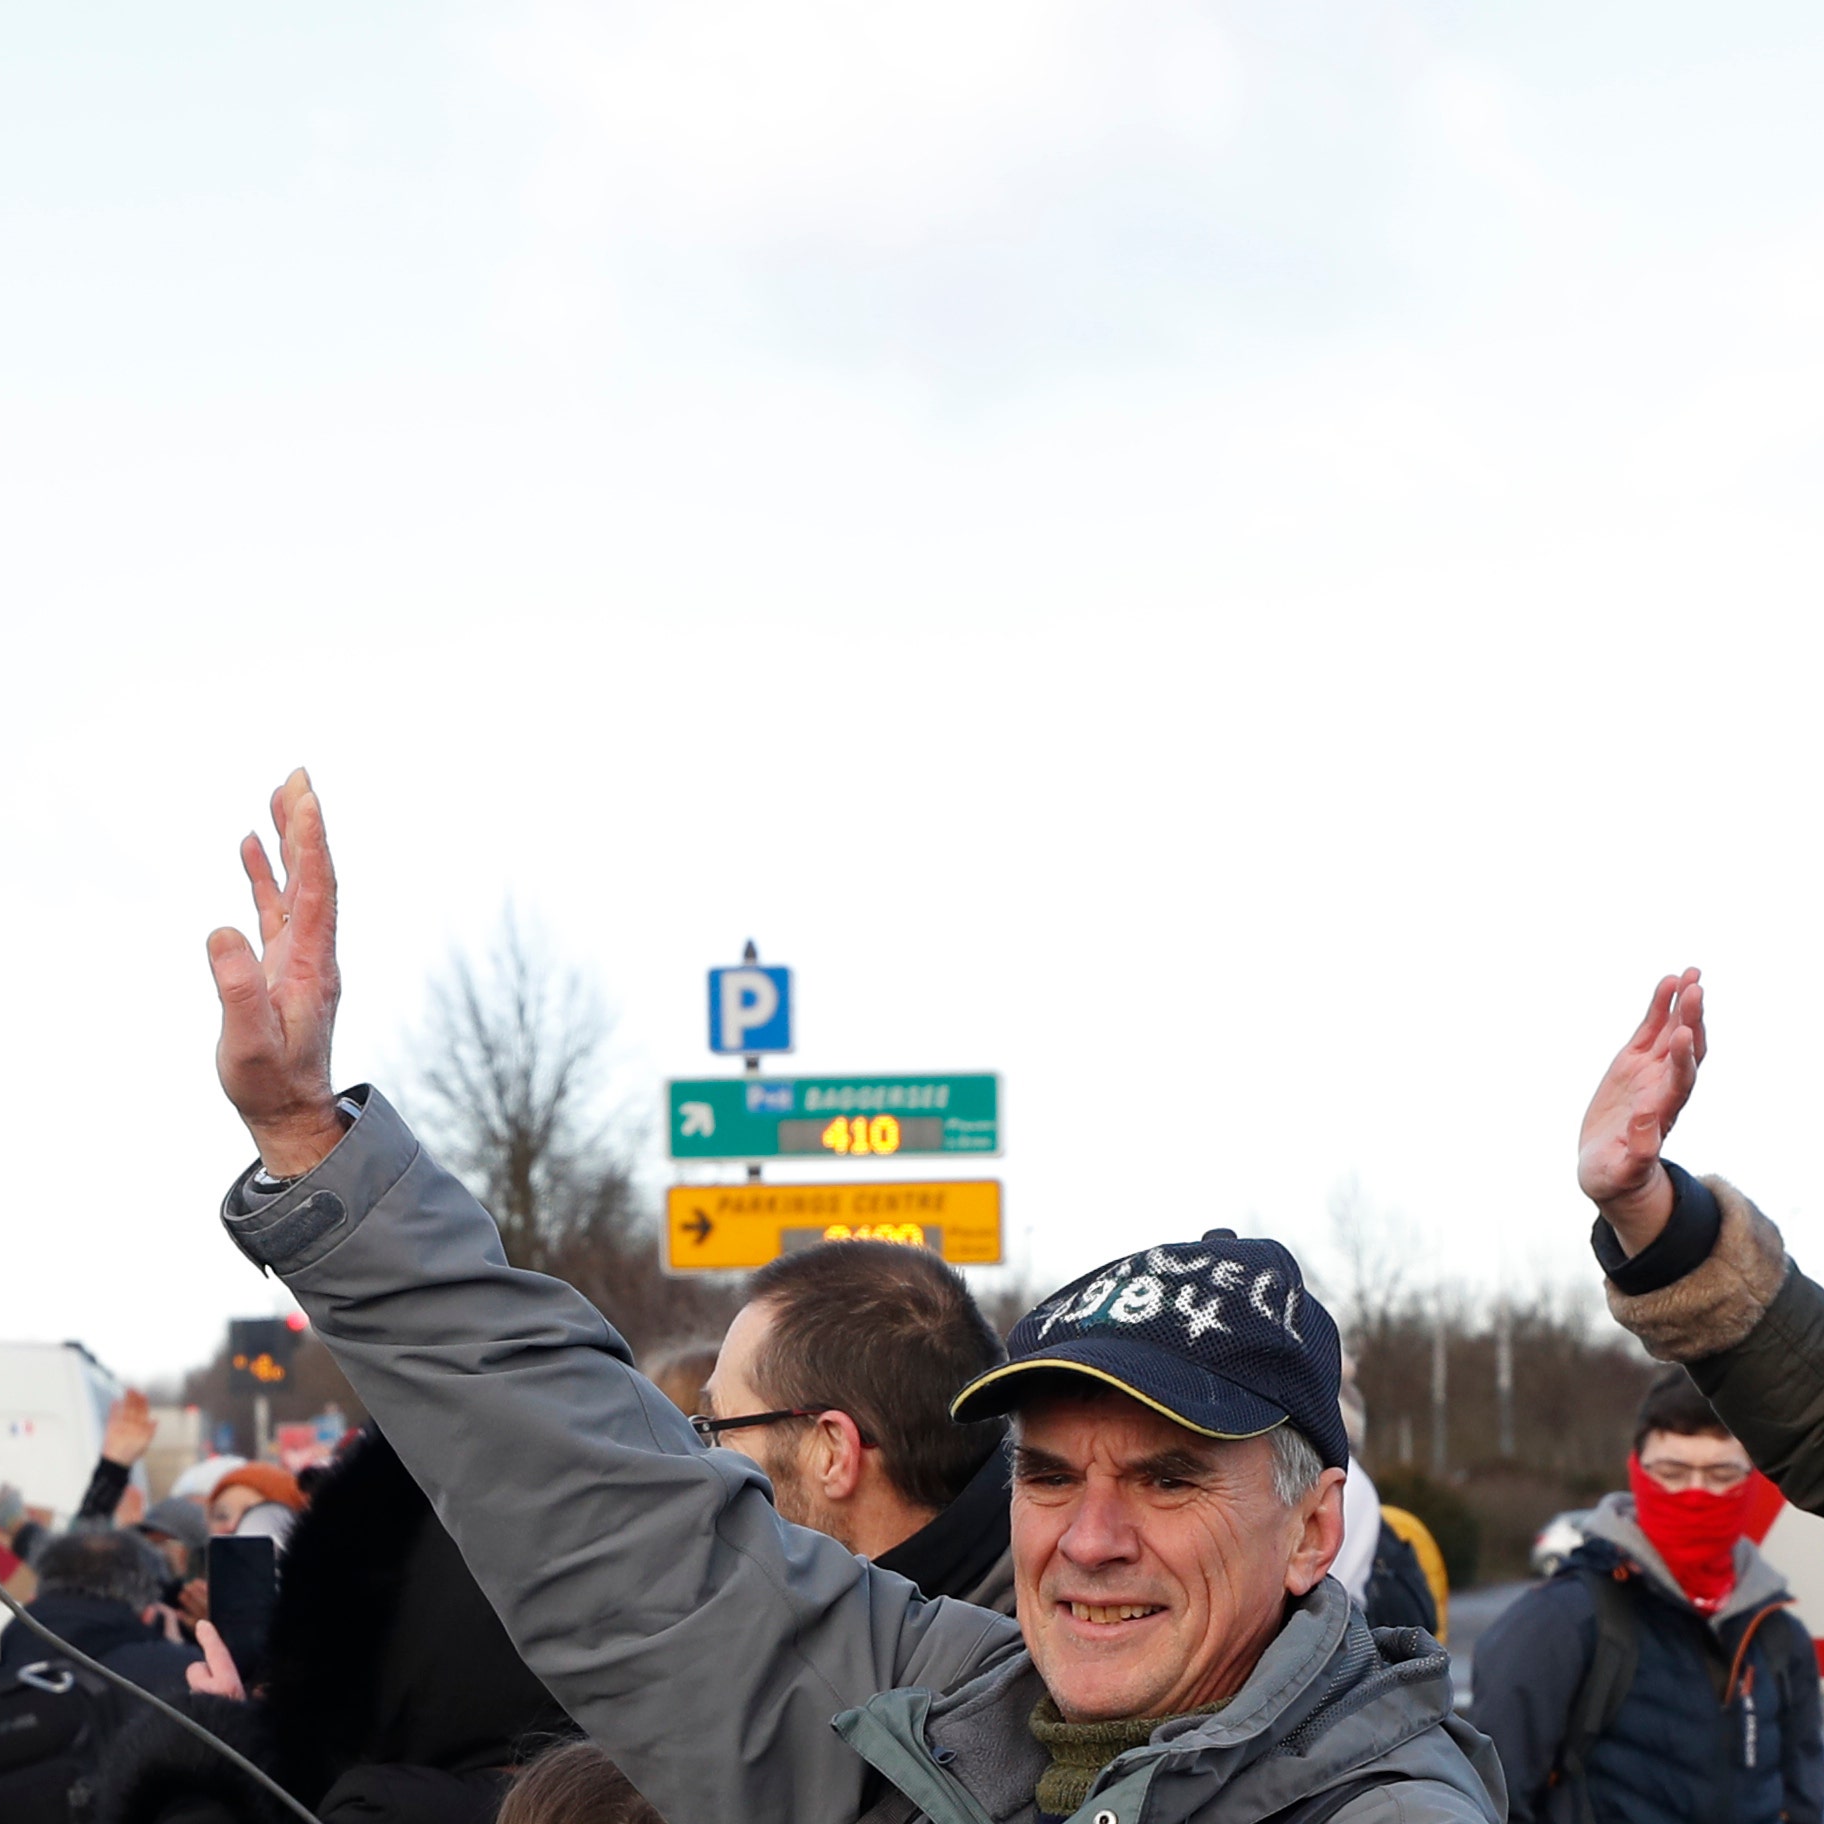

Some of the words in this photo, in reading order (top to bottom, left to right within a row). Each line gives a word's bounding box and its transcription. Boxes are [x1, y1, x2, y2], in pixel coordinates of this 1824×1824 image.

[720, 969, 778, 1051] P
[822, 1114, 901, 1156] 410
[852, 1190, 946, 1214] CENTRE
